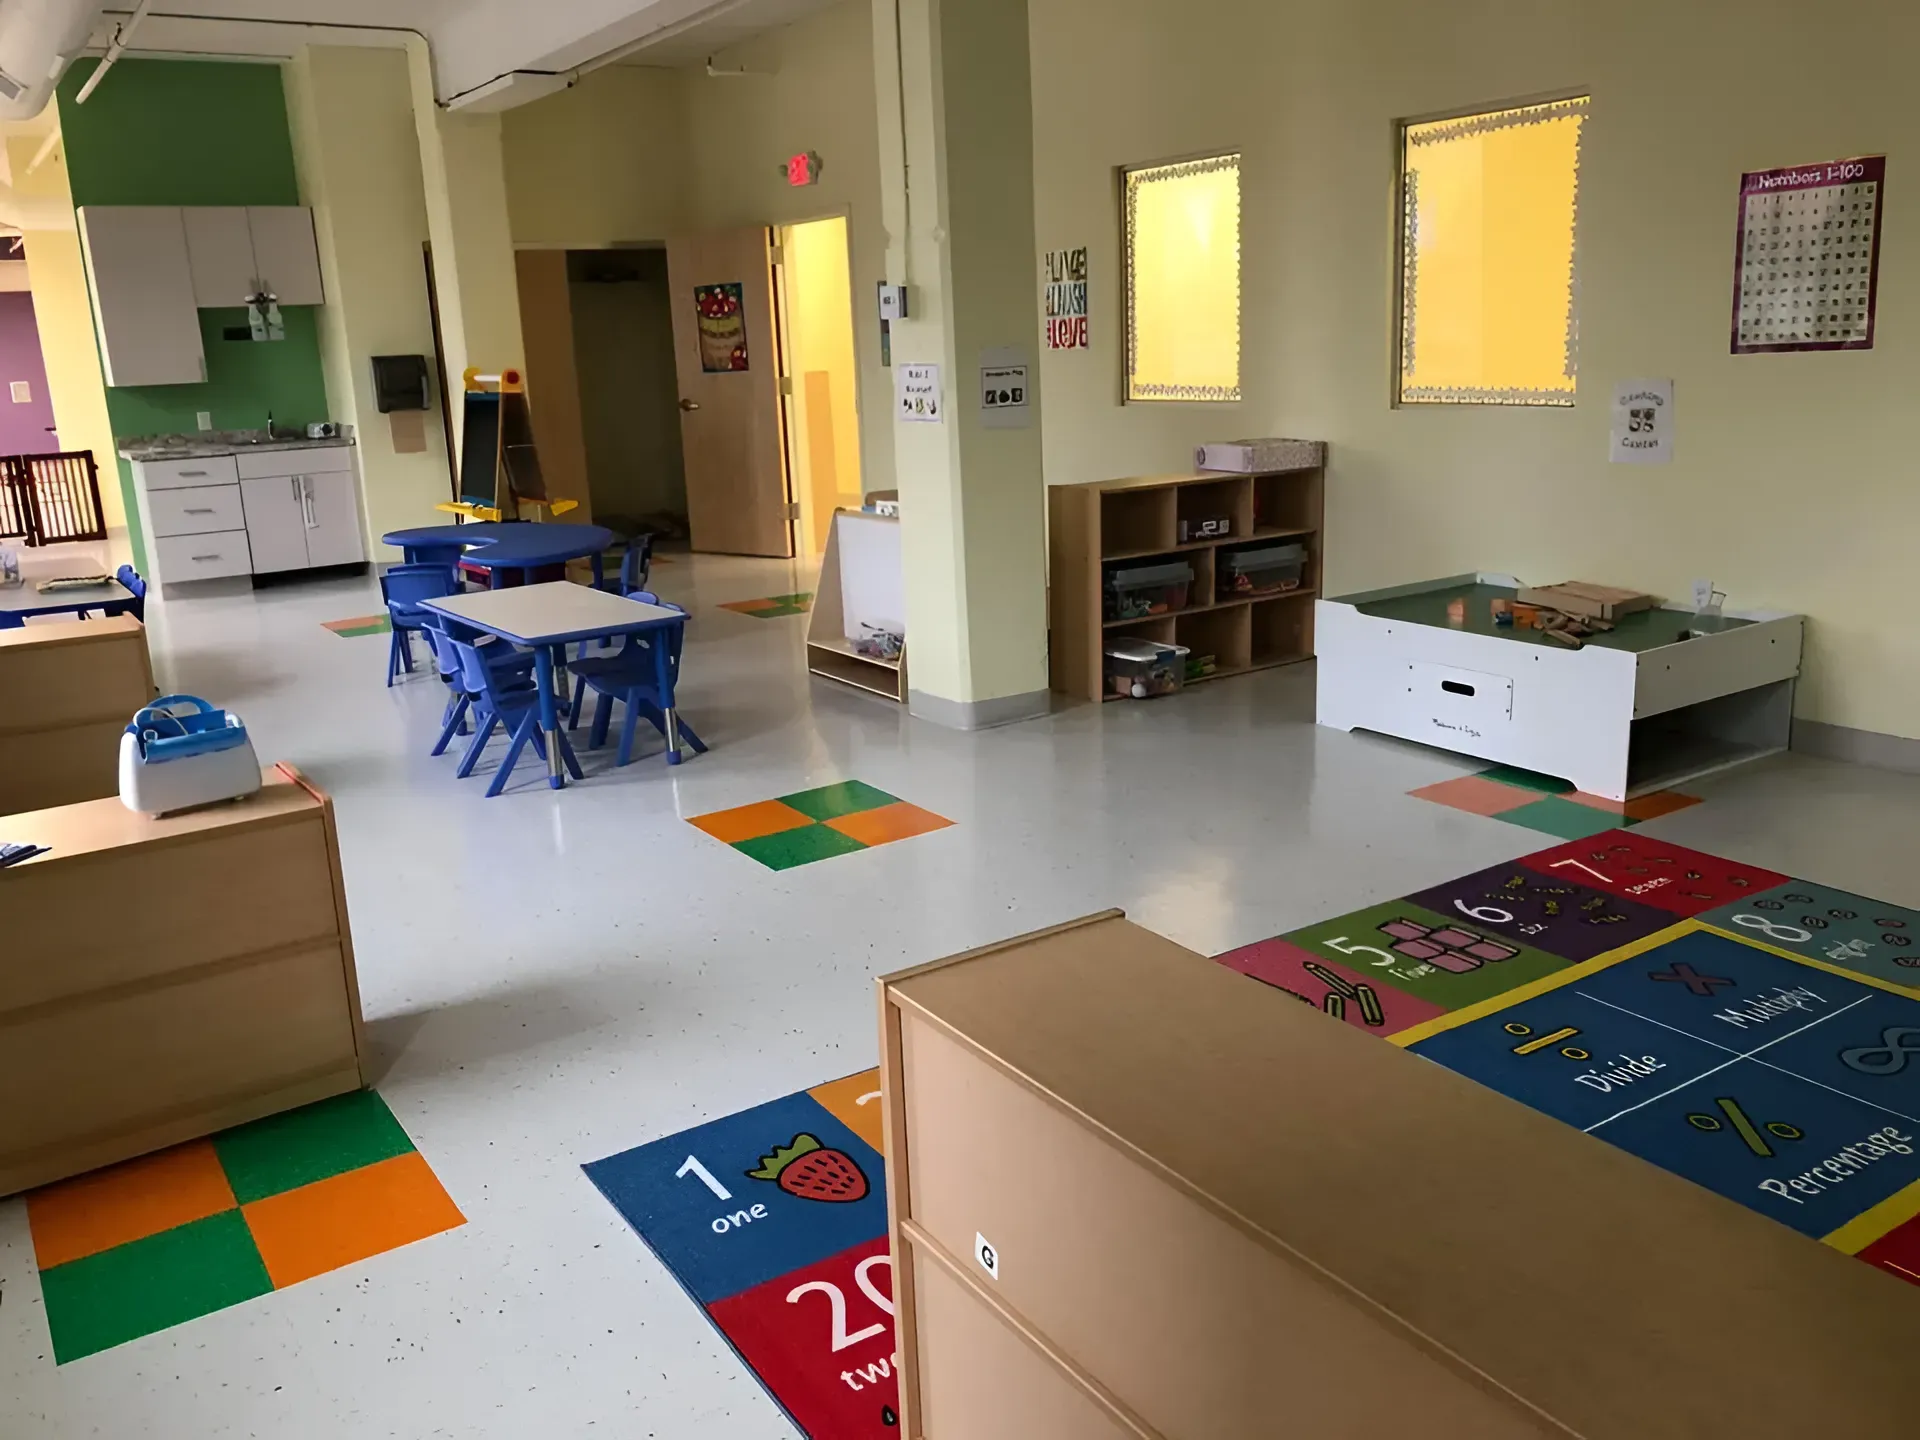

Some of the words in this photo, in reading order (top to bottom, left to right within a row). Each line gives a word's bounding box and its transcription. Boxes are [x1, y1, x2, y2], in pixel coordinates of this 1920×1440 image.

[1549, 858, 1613, 882] 7
[1454, 899, 1514, 922] 6
[1731, 914, 1813, 942] 8
[1322, 936, 1395, 966] 5
[1712, 986, 1828, 1029] Multiply
[1574, 1053, 1667, 1093] Divide
[675, 1154, 733, 1201] 1
[1757, 1124, 1914, 1205] Percentage
[711, 1203, 769, 1234] one
[981, 1245, 994, 1270] G
